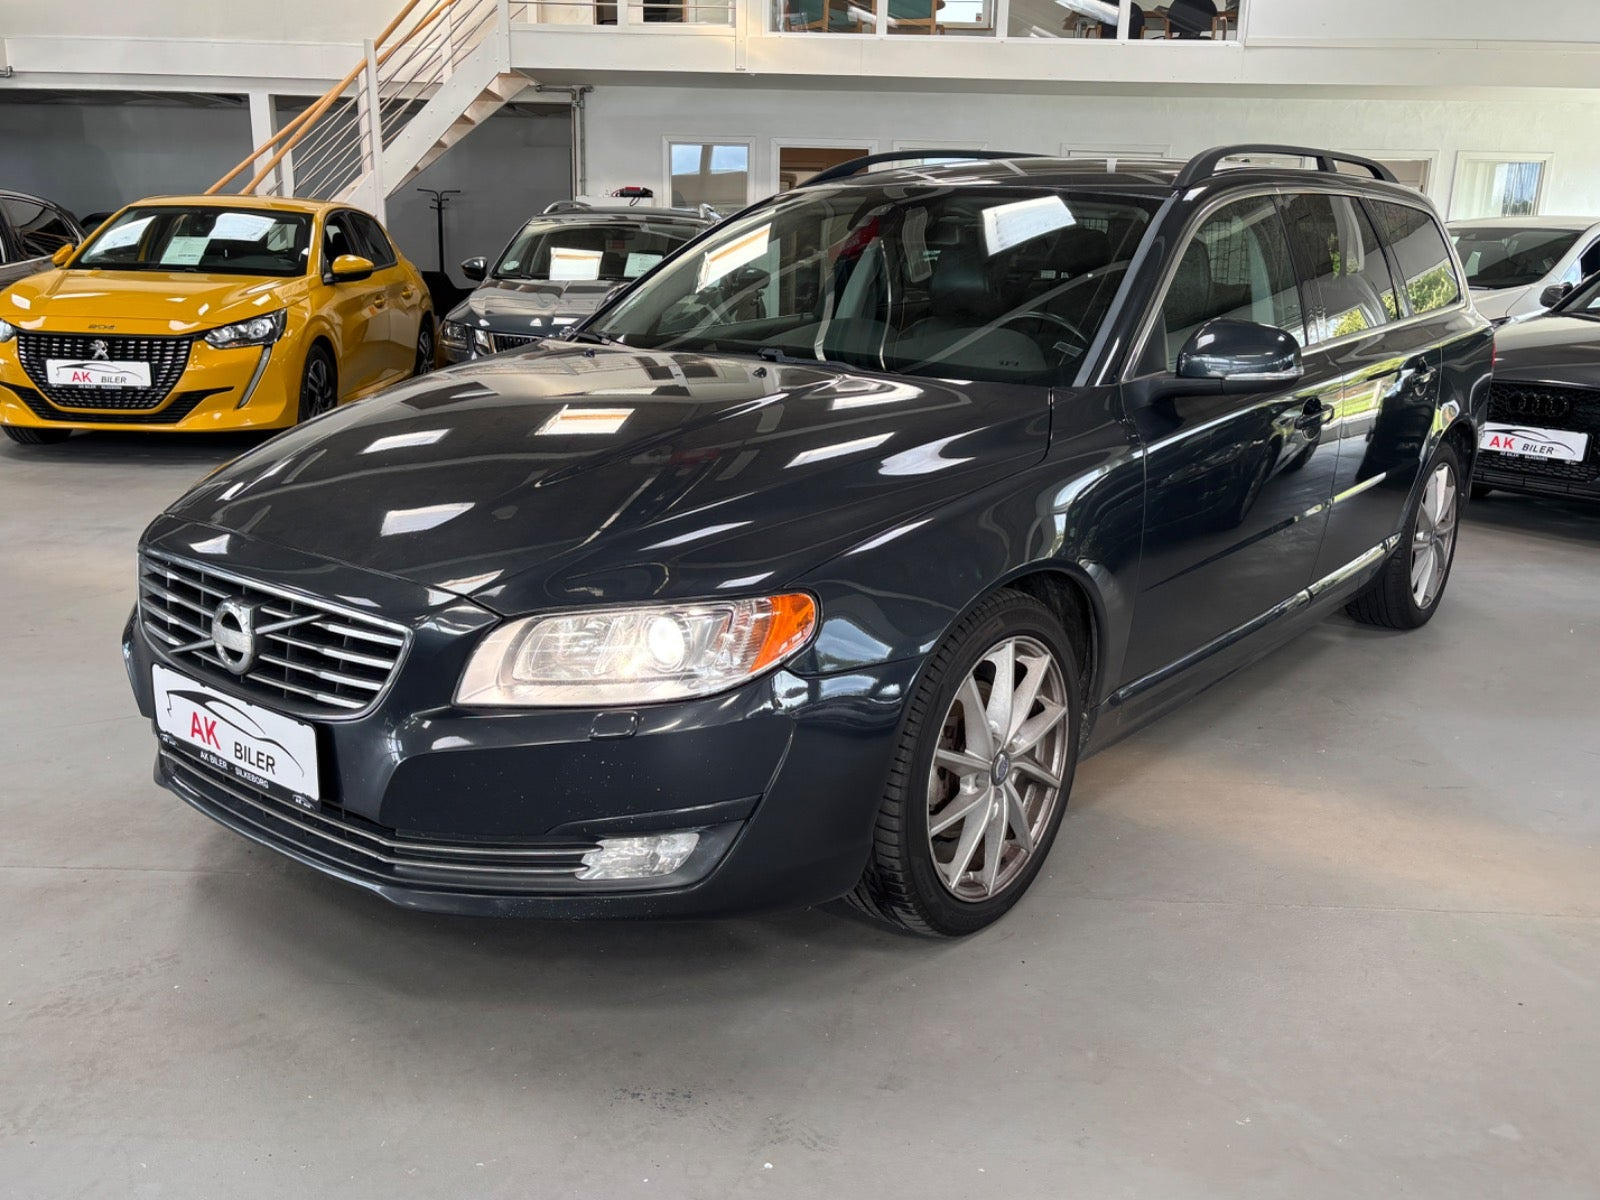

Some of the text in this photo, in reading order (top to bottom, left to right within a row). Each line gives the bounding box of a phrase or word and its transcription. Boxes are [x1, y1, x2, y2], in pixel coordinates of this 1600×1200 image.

[71, 371, 127, 384] AK BILER
[1489, 435, 1516, 450] AK
[1522, 443, 1555, 455] BILER
[190, 711, 276, 775] AK BILER
[200, 751, 209, 761] AK
[209, 755, 228, 770] BILER
